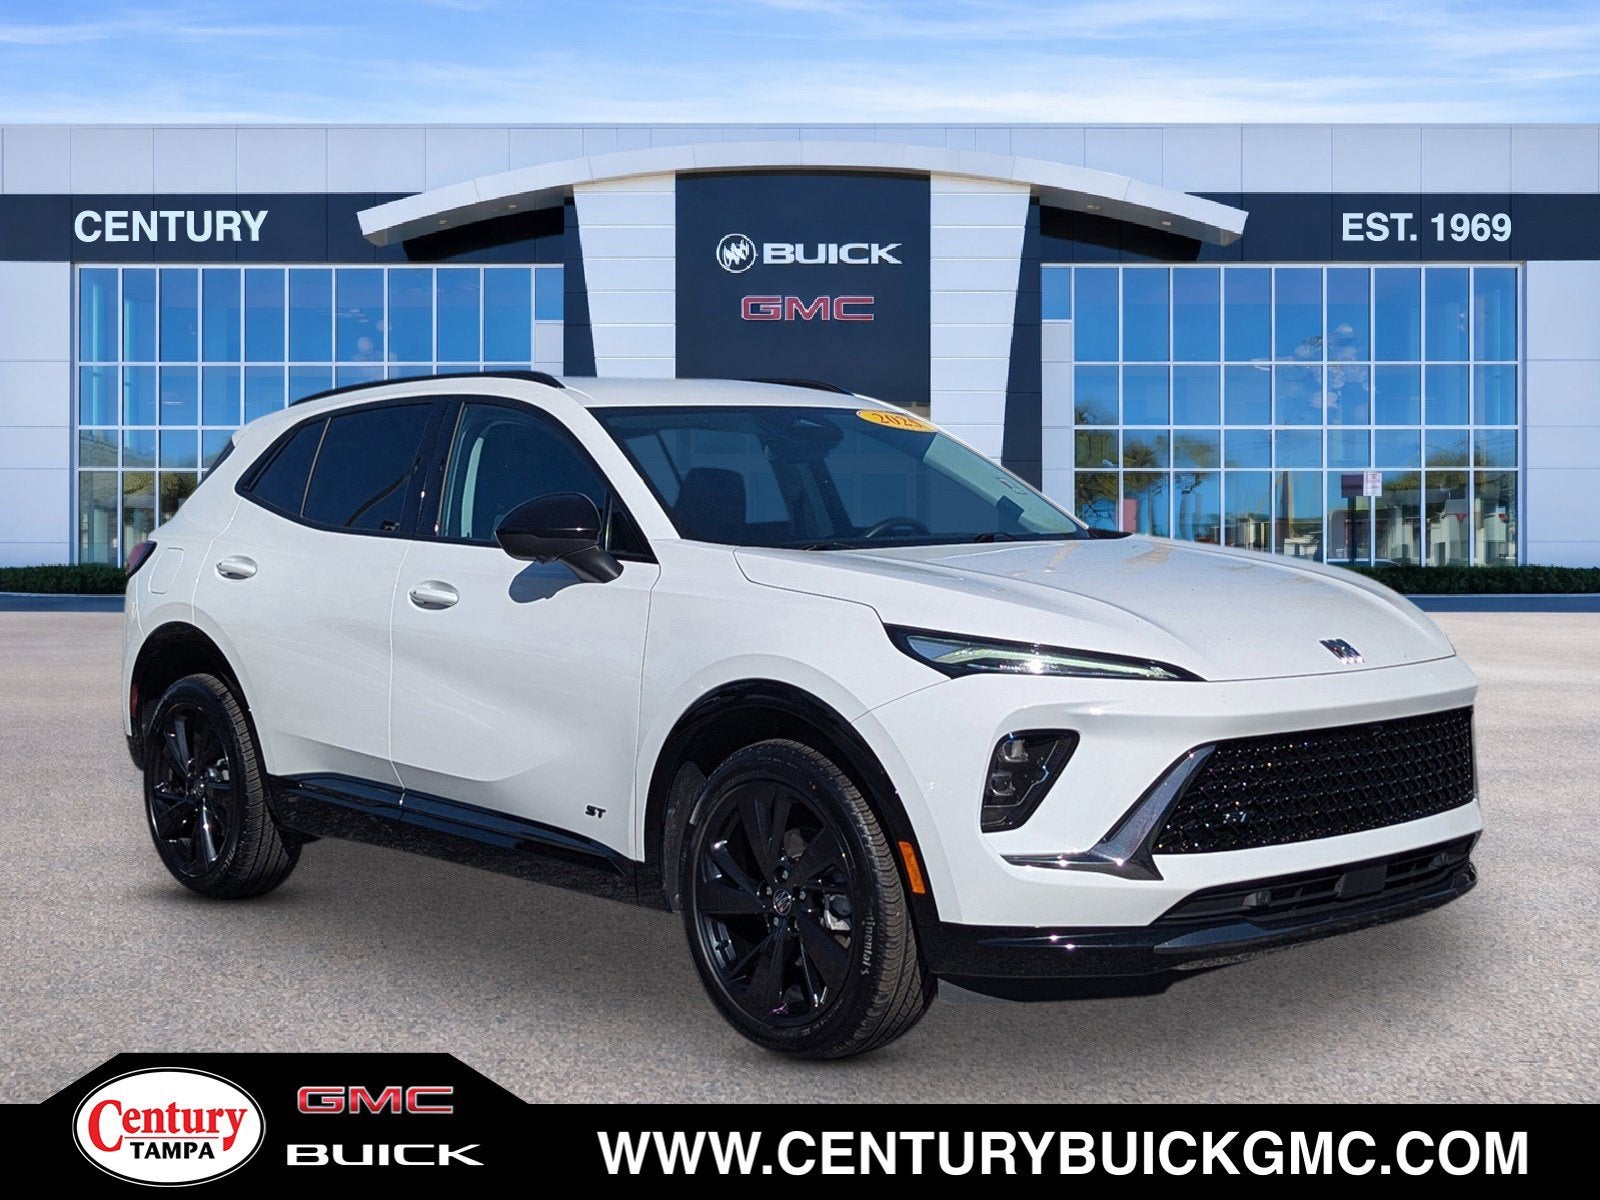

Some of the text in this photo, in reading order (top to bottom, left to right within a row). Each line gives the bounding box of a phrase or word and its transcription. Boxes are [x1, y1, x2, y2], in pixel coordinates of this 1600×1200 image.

[74, 210, 268, 242] CENTURY
[1342, 212, 1512, 242] EST. 1969
[763, 243, 902, 264] BUICK
[741, 295, 874, 321] GMC
[585, 804, 606, 819] ST
